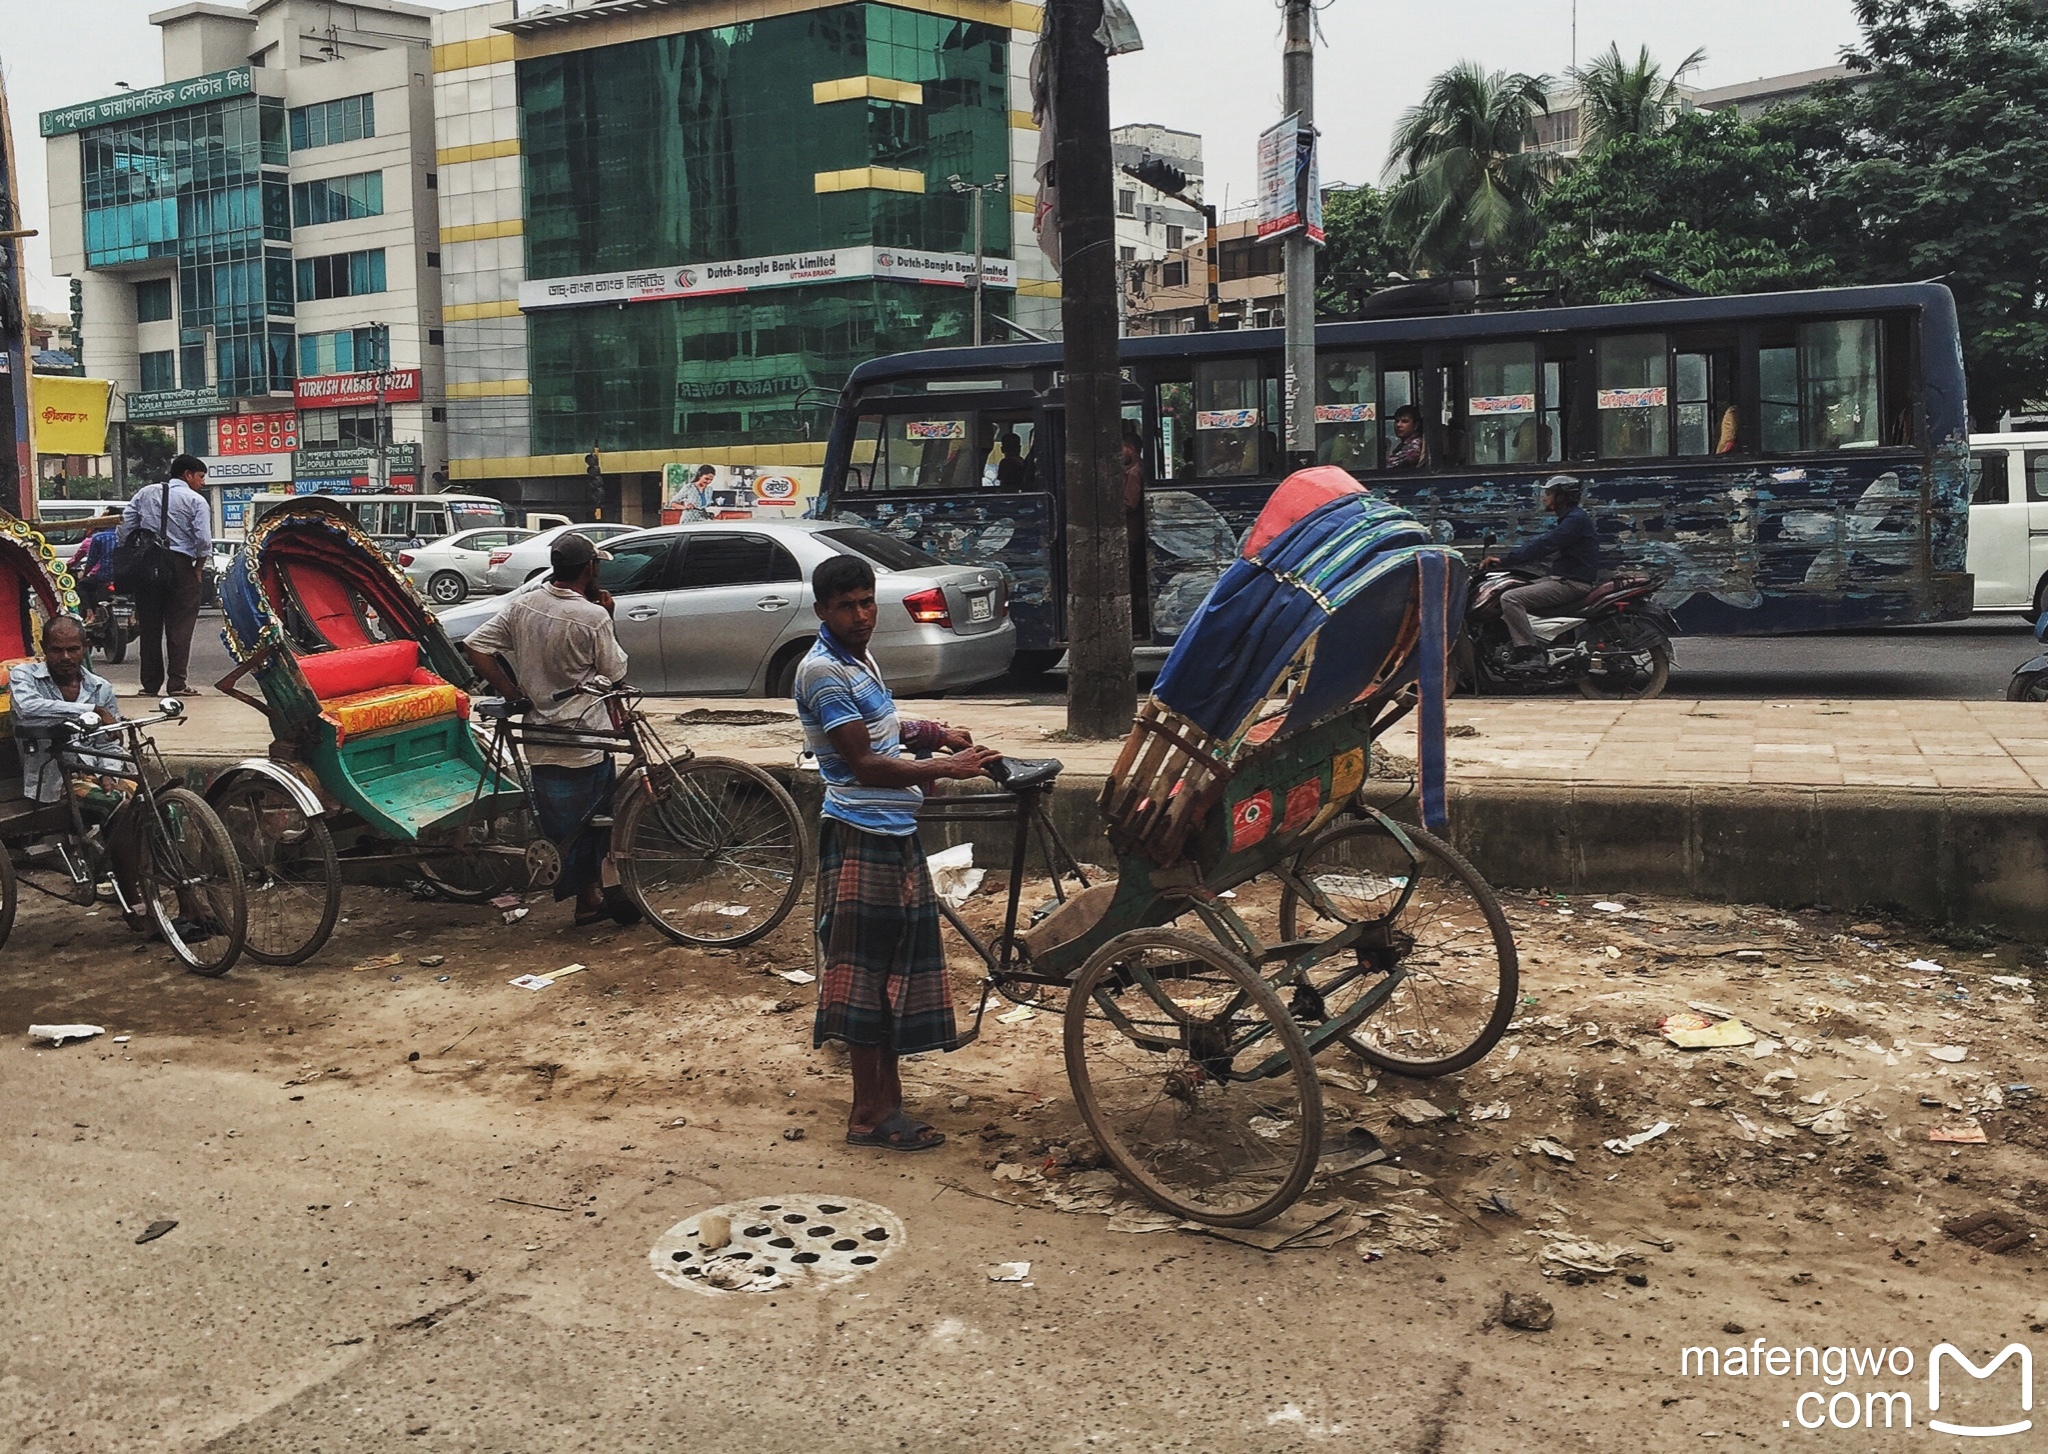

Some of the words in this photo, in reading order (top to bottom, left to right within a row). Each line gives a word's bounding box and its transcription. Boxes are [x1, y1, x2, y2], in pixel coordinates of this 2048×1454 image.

[55, 106, 96, 128] পপুলার
[99, 88, 175, 117] ডায়াগনস্টিক
[179, 78, 222, 101] সেন্টার
[226, 70, 250, 91] লিঃ
[707, 260, 769, 280] Dutch-Bangla
[772, 258, 797, 273] Bank
[800, 254, 836, 269] Limited
[897, 256, 953, 273] Dutch-Bangla
[956, 261, 976, 273] Bank
[789, 271, 812, 280] UTTARA
[813, 269, 836, 278] BRANCH
[596, 279, 624, 292] ব্যাংক
[626, 273, 665, 289] লিমিটেড
[299, 379, 338, 398] TURKISH
[384, 373, 413, 391] PIZZA
[138, 401, 162, 410] POPULAR
[164, 399, 195, 409] DIAGNOSTIC
[307, 459, 335, 468] POPULAR
[401, 456, 414, 464] LTD.
[208, 463, 273, 478] CRESCENT
[295, 481, 308, 492] SKY
[227, 504, 241, 512] SKY
